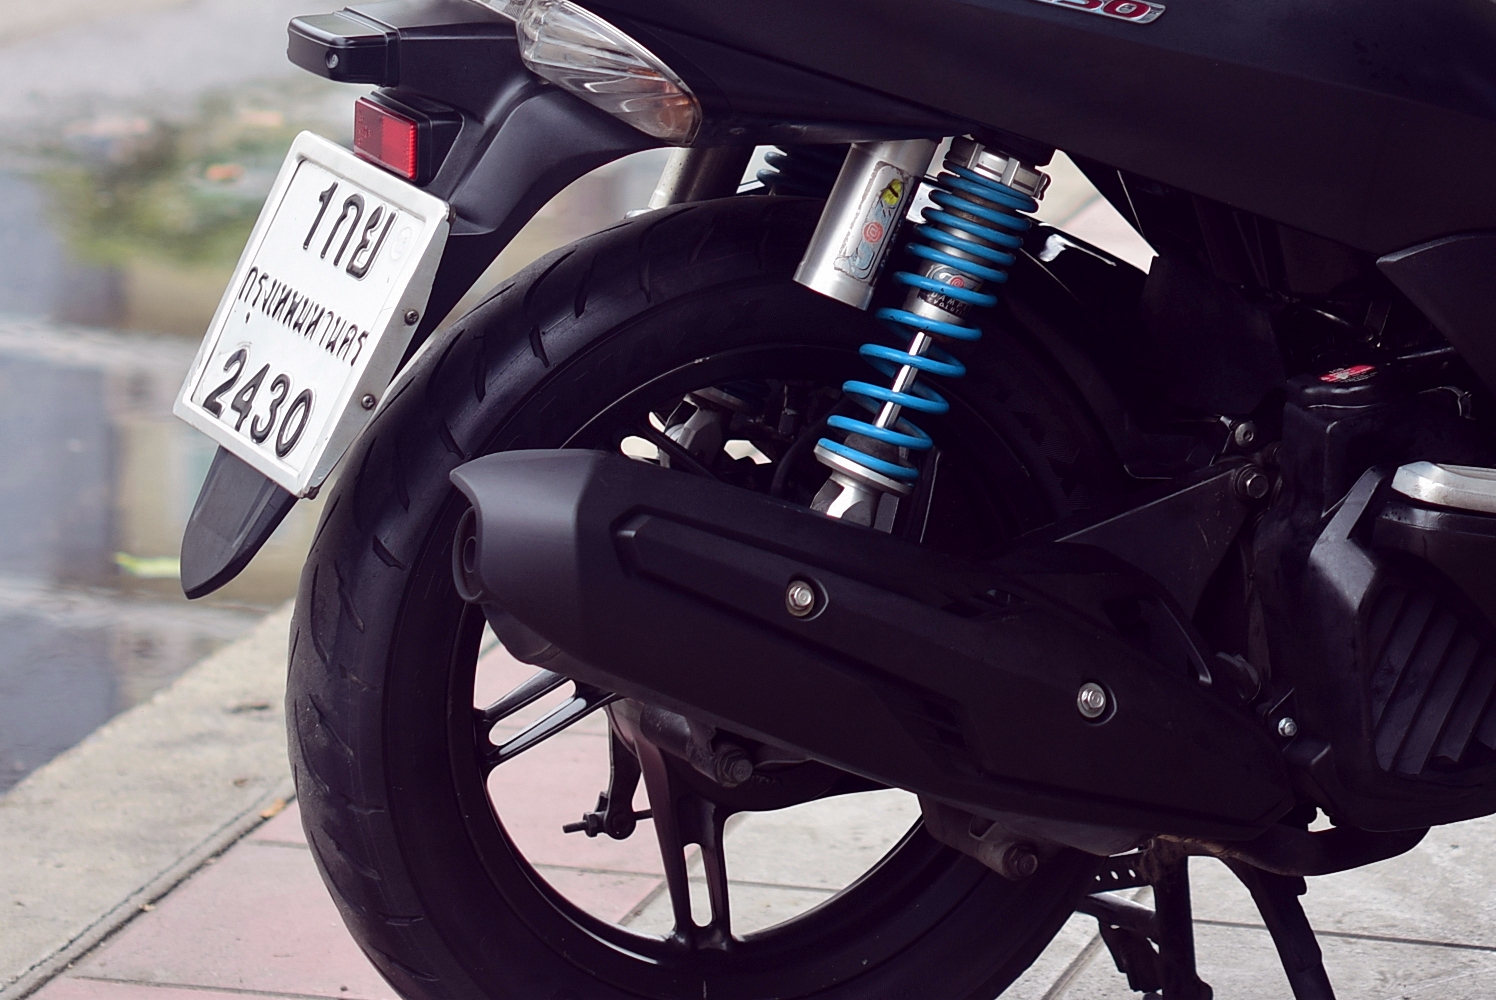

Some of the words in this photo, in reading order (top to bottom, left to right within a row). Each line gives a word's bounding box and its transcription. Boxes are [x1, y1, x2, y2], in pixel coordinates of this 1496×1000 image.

[238, 266, 368, 367] กรุงเทพมหานคร
[202, 348, 317, 459] 2430
